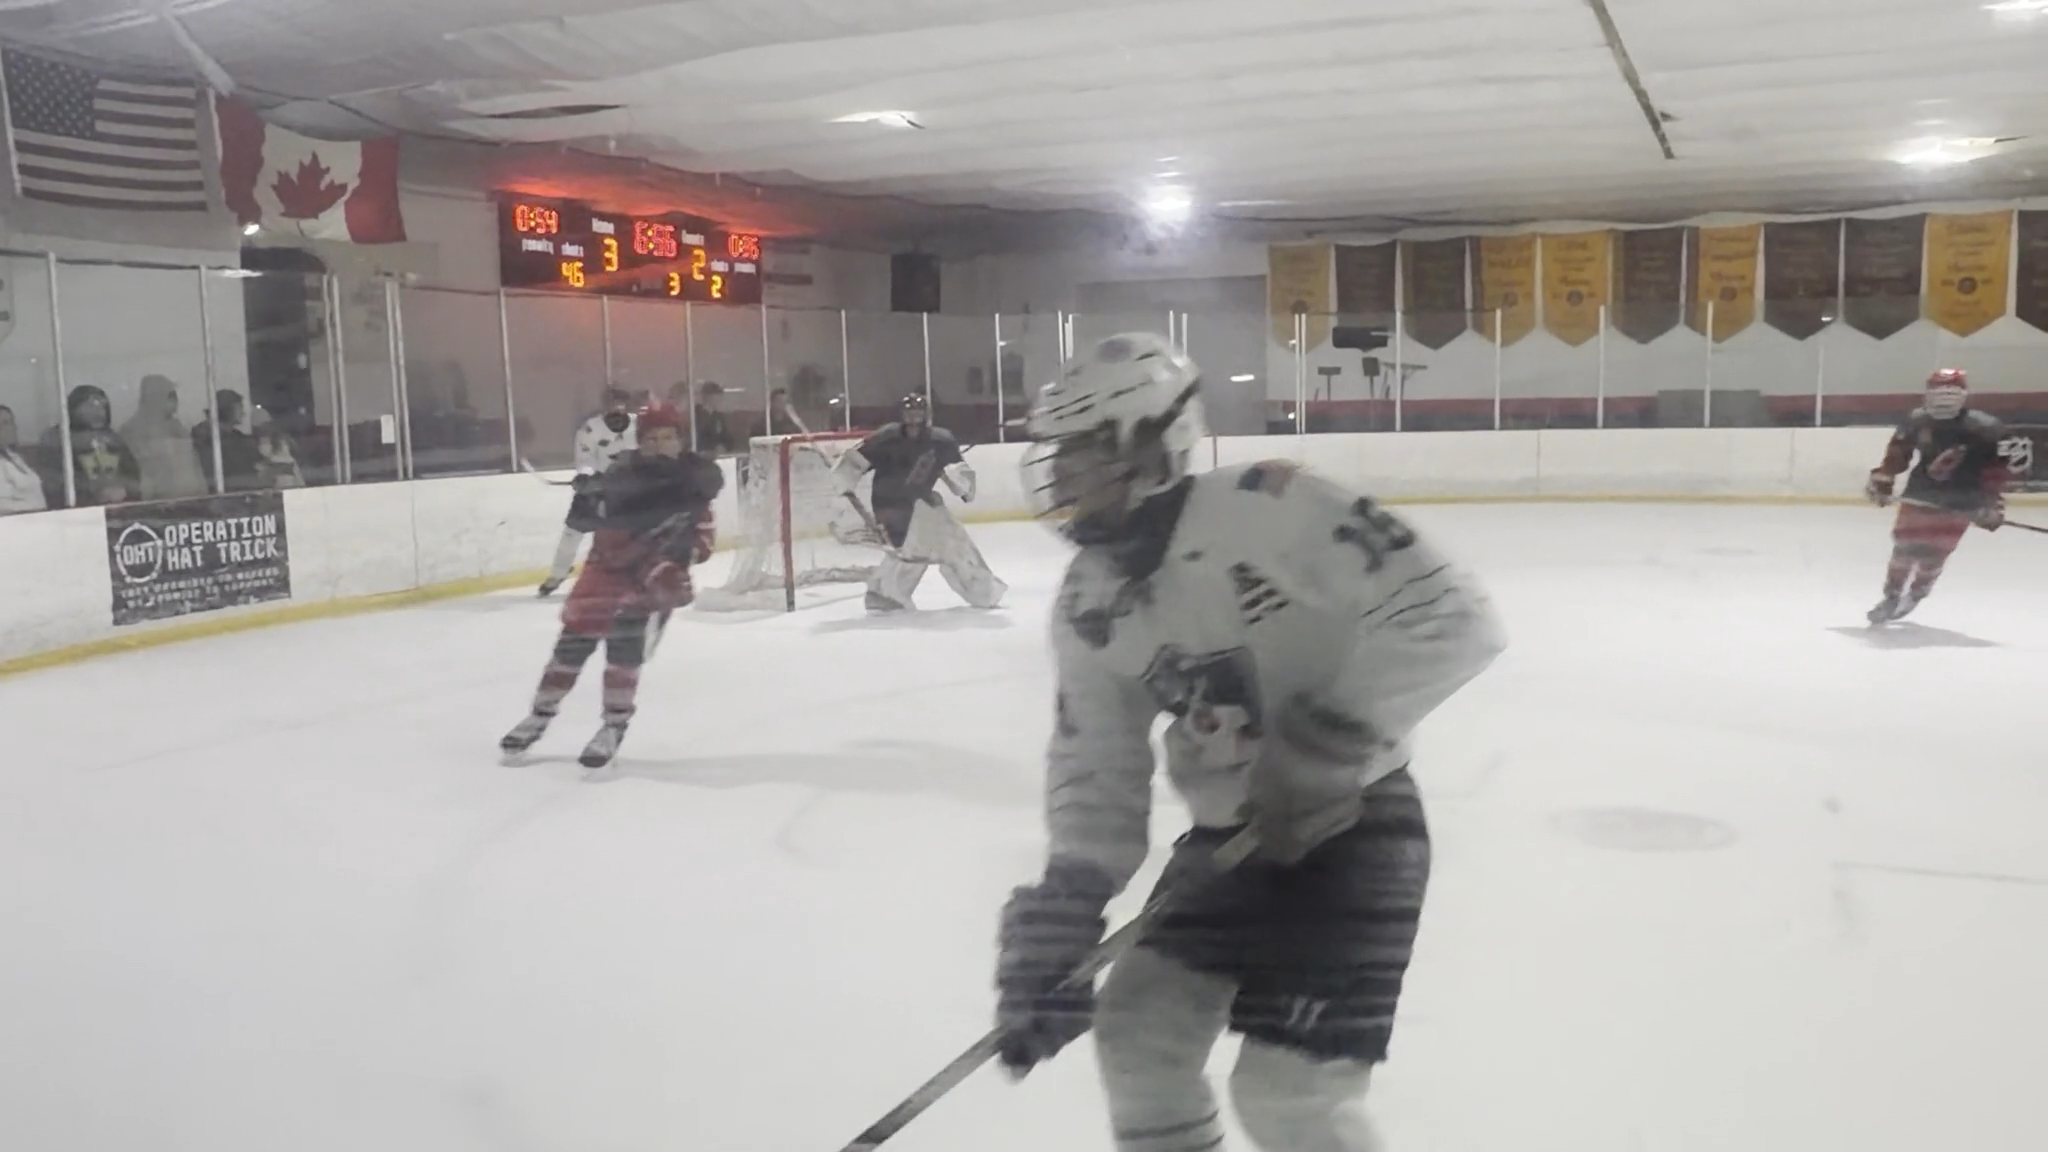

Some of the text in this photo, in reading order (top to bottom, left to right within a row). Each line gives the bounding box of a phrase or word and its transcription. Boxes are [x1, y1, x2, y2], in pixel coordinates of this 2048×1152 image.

[515, 204, 559, 235] 0:54
[602, 237, 619, 273] 3
[691, 248, 707, 282] 2
[561, 261, 586, 289] 46
[669, 271, 681, 297] 3
[711, 274, 724, 299] 2
[164, 513, 277, 548] OPERATION
[122, 541, 155, 566] OHT
[167, 536, 279, 572] HAT TRICK
